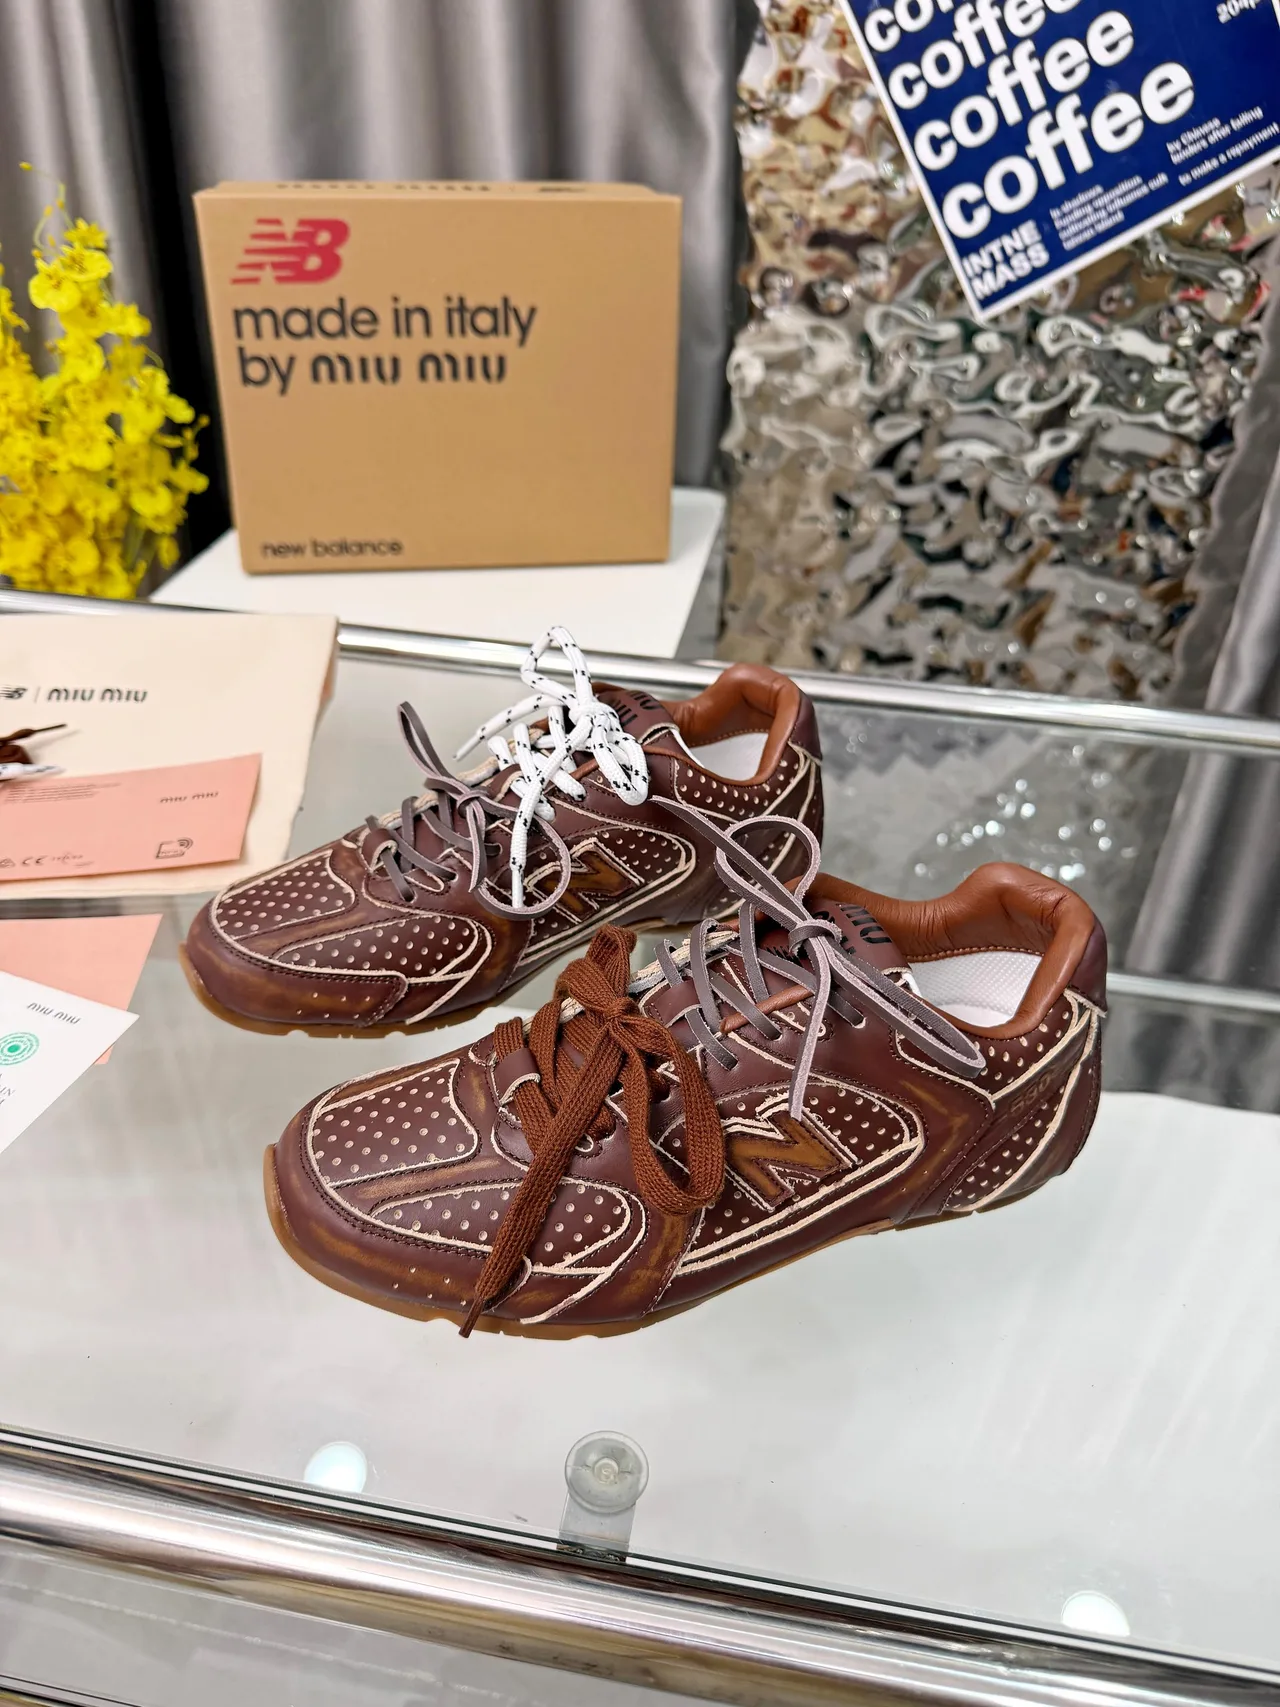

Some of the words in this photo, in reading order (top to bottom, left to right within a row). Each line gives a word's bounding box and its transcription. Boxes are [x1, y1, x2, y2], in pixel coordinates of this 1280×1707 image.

[914, 10, 1134, 171] coffee
[943, 62, 1195, 238] coffee
[1191, 157, 1220, 180] make
[1225, 121, 1280, 160] repayment
[230, 218, 350, 285] NB
[962, 219, 1042, 277] INTNE
[970, 242, 1050, 299] MASS
[233, 297, 379, 340] made
[392, 295, 432, 338] in
[445, 295, 537, 347] italy
[237, 347, 295, 396] by
[262, 541, 306, 559] new
[311, 536, 404, 557] balance
